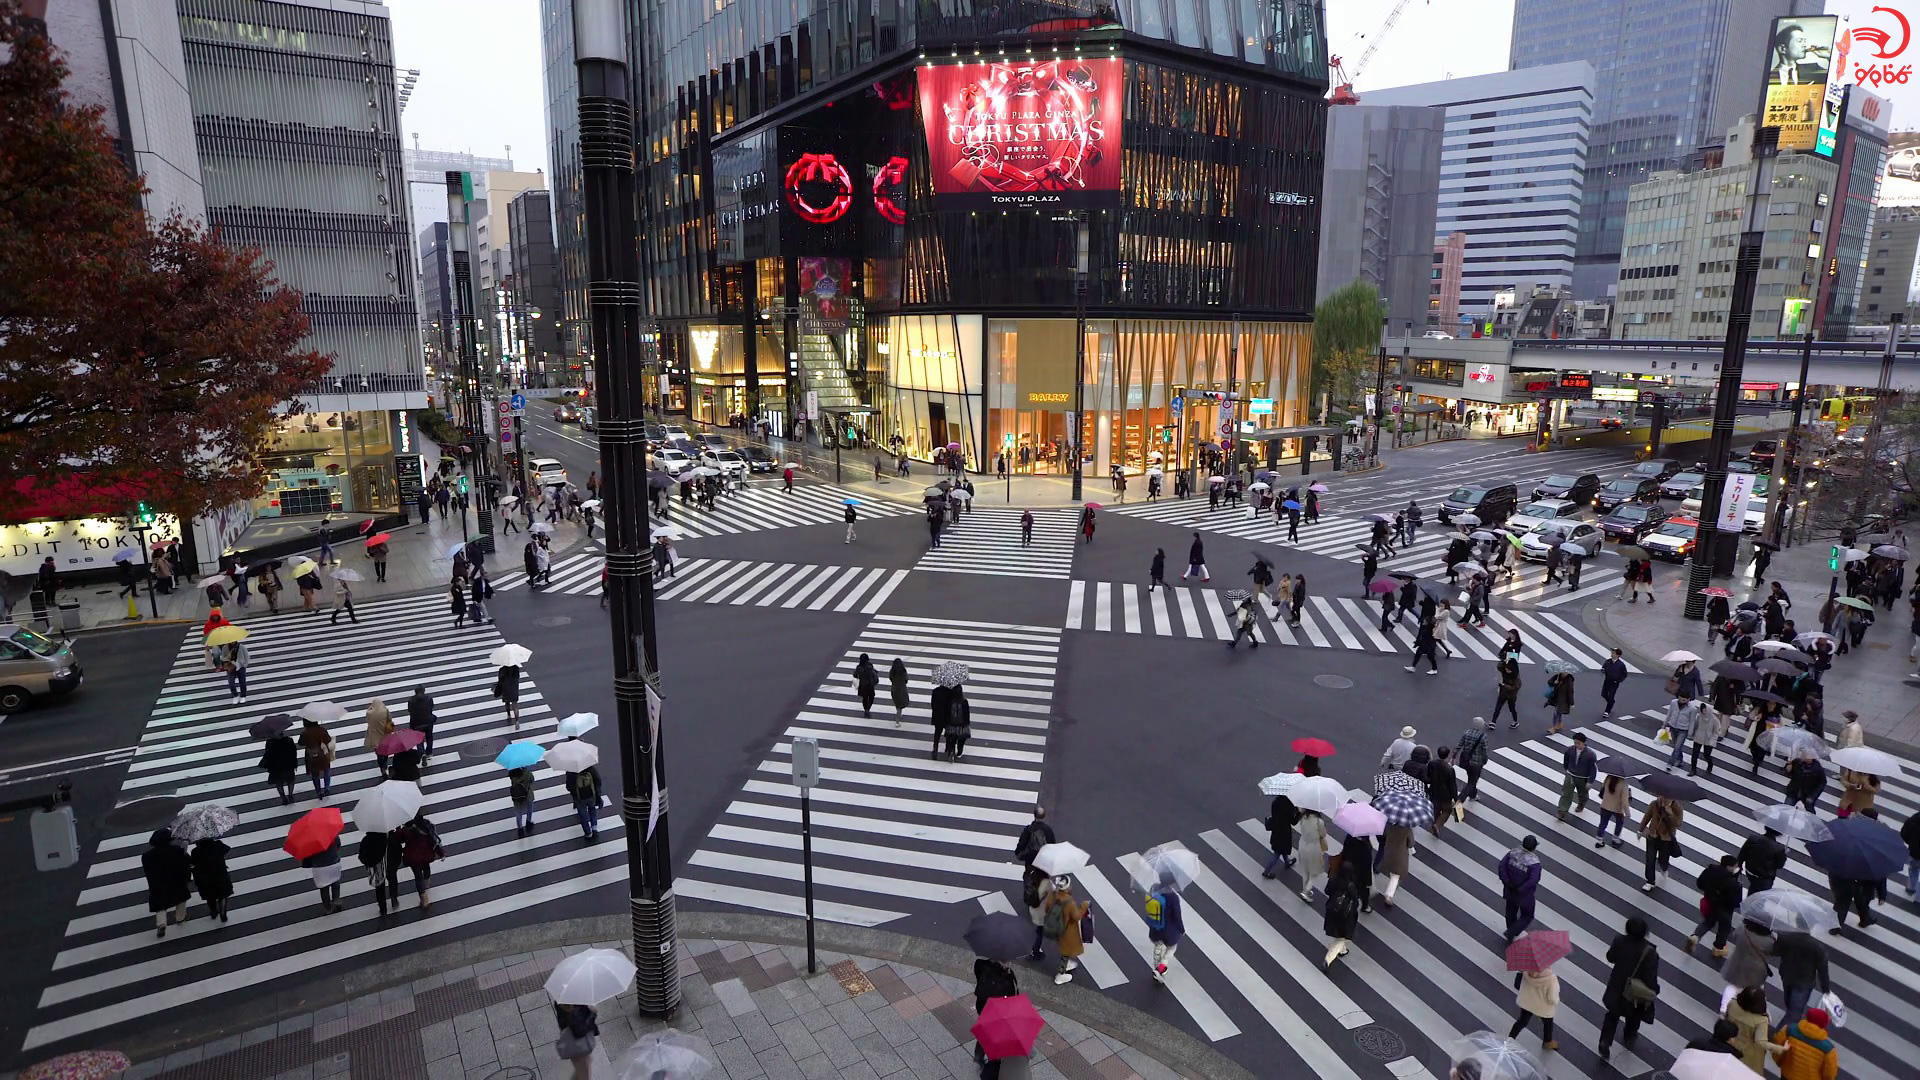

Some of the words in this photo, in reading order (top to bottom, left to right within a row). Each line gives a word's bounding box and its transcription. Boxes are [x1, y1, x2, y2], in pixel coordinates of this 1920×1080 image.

[975, 112, 1007, 121] TOKYU
[1012, 111, 1041, 120] PLAZA
[1045, 110, 1078, 119] GINZA
[948, 120, 1105, 145] CHRISTMAS
[992, 195, 1025, 203] TOKYU
[1027, 195, 1061, 203] PLAZA
[722, 199, 779, 226] CHRISTMAS
[1029, 393, 1069, 402] BALLY
[399, 411, 407, 427] Sony
[400, 427, 410, 453] Building
[1727, 476, 1745, 521] ヒカリミチ
[83, 533, 160, 551] TOKYO
